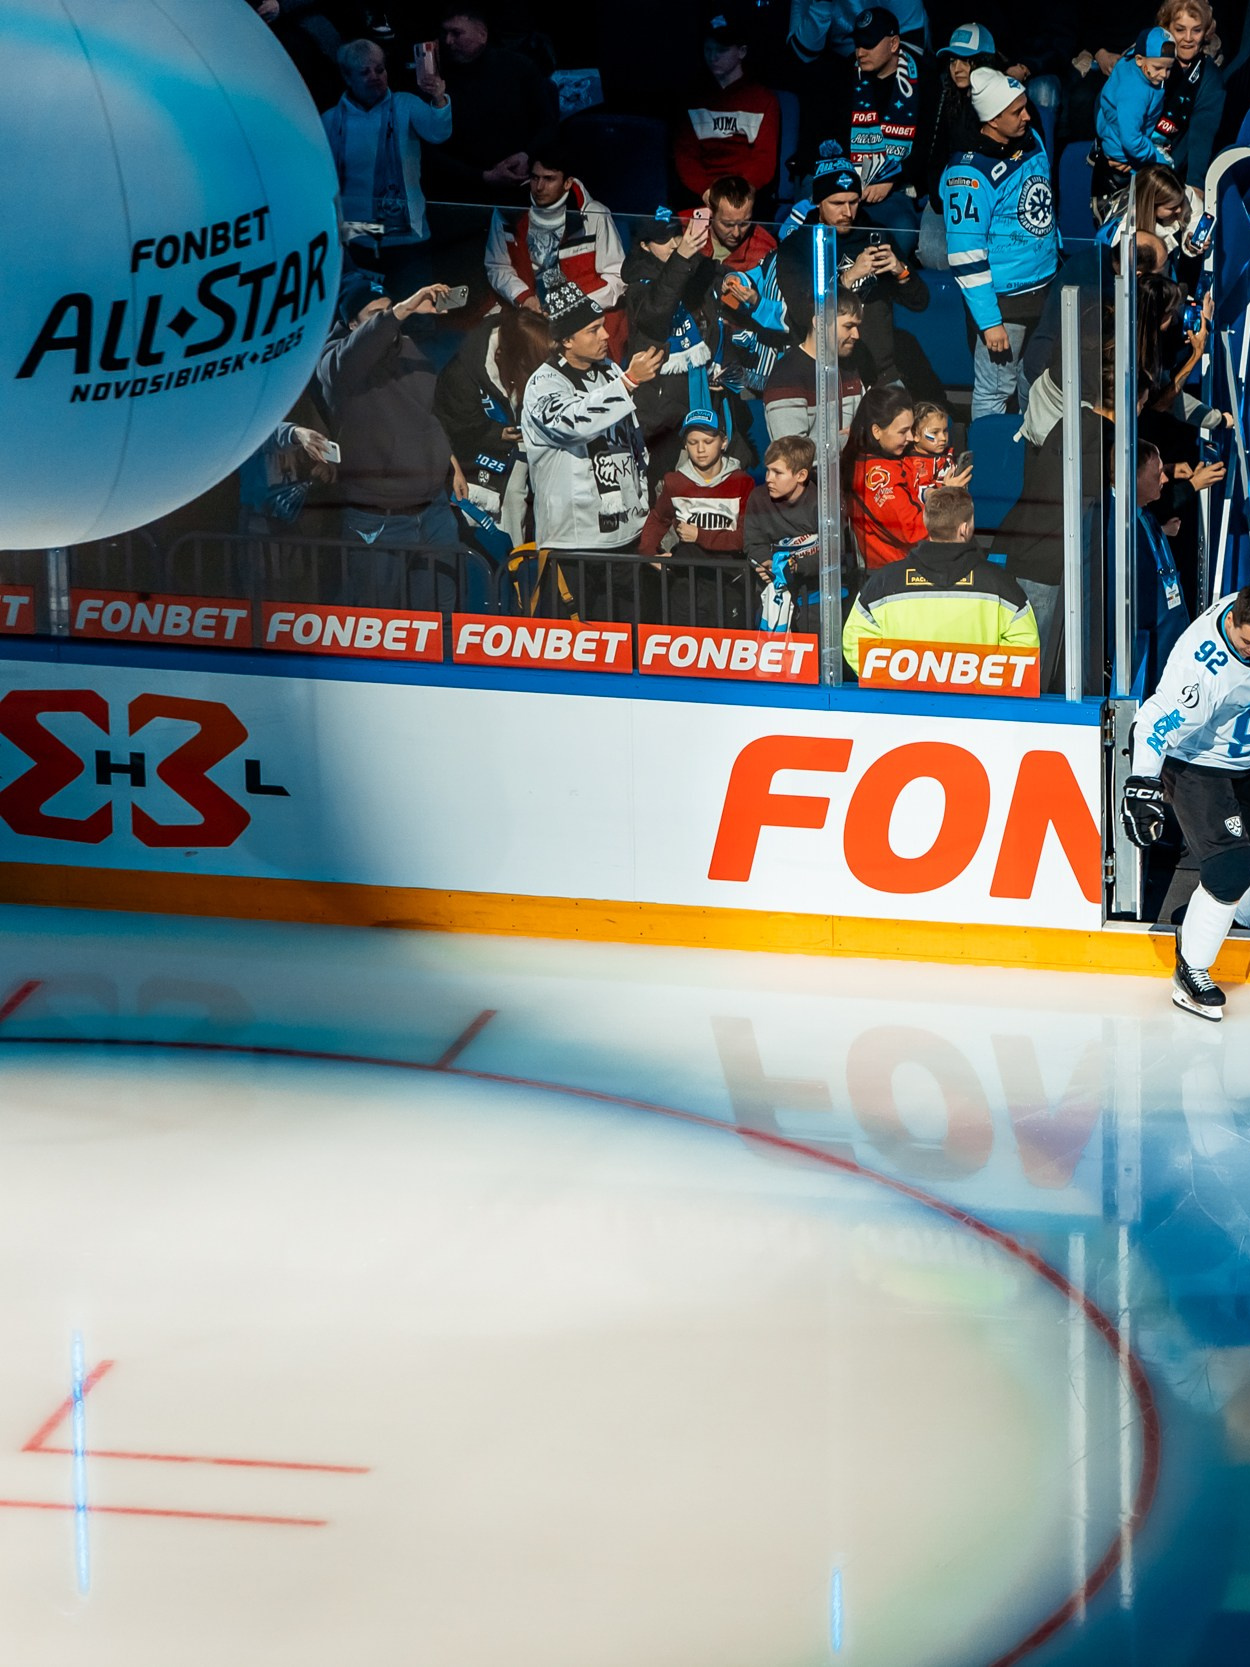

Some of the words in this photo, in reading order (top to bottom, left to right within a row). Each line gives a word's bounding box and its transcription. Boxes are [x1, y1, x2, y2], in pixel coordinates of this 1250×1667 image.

[881, 124, 914, 136] FONBET
[949, 192, 980, 225] 54
[131, 205, 269, 272] FONBET
[71, 355, 247, 403] NOVOSIBIRSK
[261, 331, 304, 364] 2025
[0, 595, 30, 626] T
[75, 600, 248, 640] FONBET
[266, 612, 439, 653] FONBET
[456, 623, 629, 664] FONBET
[641, 634, 815, 675] FONBET
[861, 647, 1037, 688] FONBET
[1194, 640, 1228, 676] 92
[1125, 787, 1164, 801] CCM
